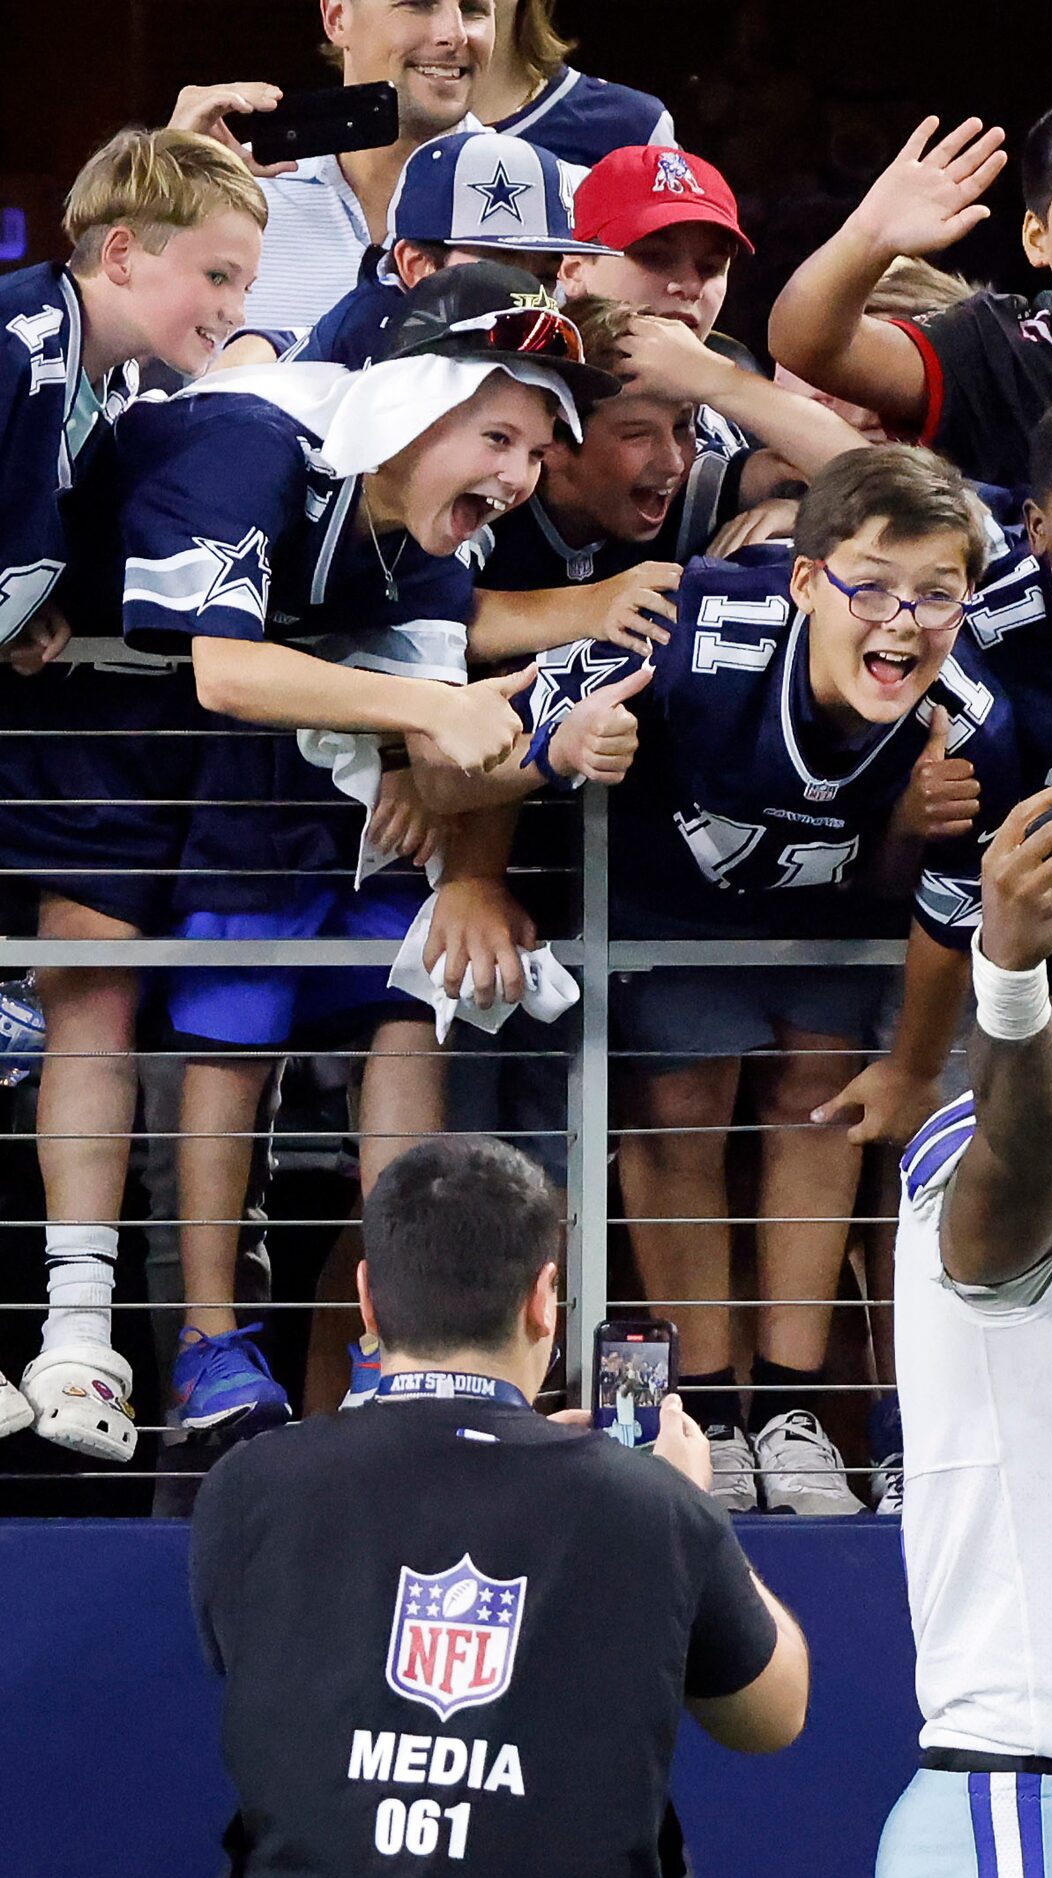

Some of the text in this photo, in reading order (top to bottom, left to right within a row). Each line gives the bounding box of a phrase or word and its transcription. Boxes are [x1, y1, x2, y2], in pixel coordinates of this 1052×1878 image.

[691, 595, 790, 675] 11
[390, 1372, 497, 1397] AT&T STADIUM
[404, 1625, 499, 1694] NFL
[347, 1729, 526, 1797] MEDIA
[374, 1798, 471, 1859] 061
